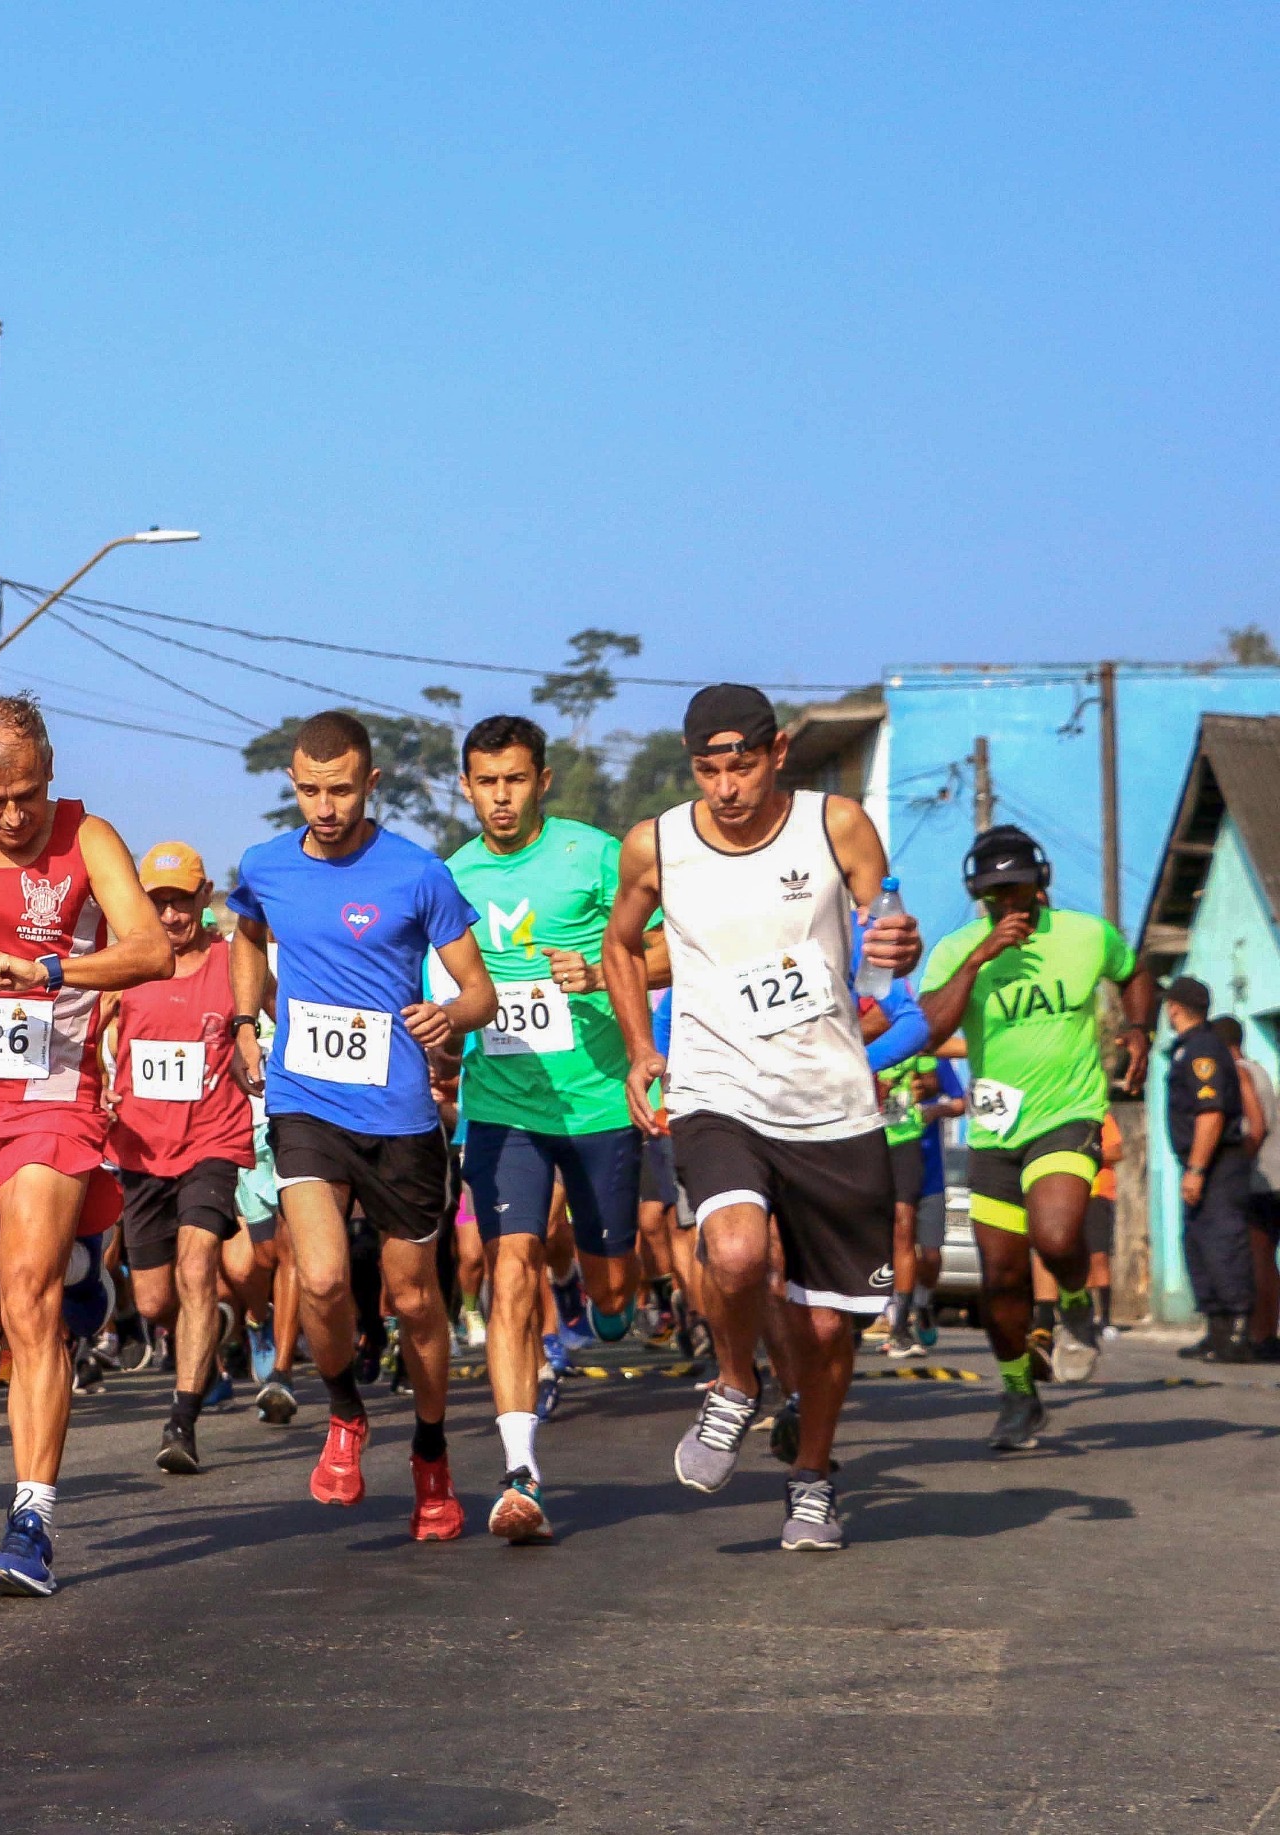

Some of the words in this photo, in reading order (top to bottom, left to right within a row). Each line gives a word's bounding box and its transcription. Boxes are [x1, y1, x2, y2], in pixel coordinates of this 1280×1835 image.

[781, 892, 812, 901] adidas
[16, 925, 62, 936] ATLETISMO
[348, 913, 370, 924] AÇO
[740, 971, 809, 1012] 122
[994, 980, 1083, 1022] VAL
[496, 1002, 550, 1032] 030
[307, 1027, 367, 1060] 108
[142, 1058, 184, 1081] 011
